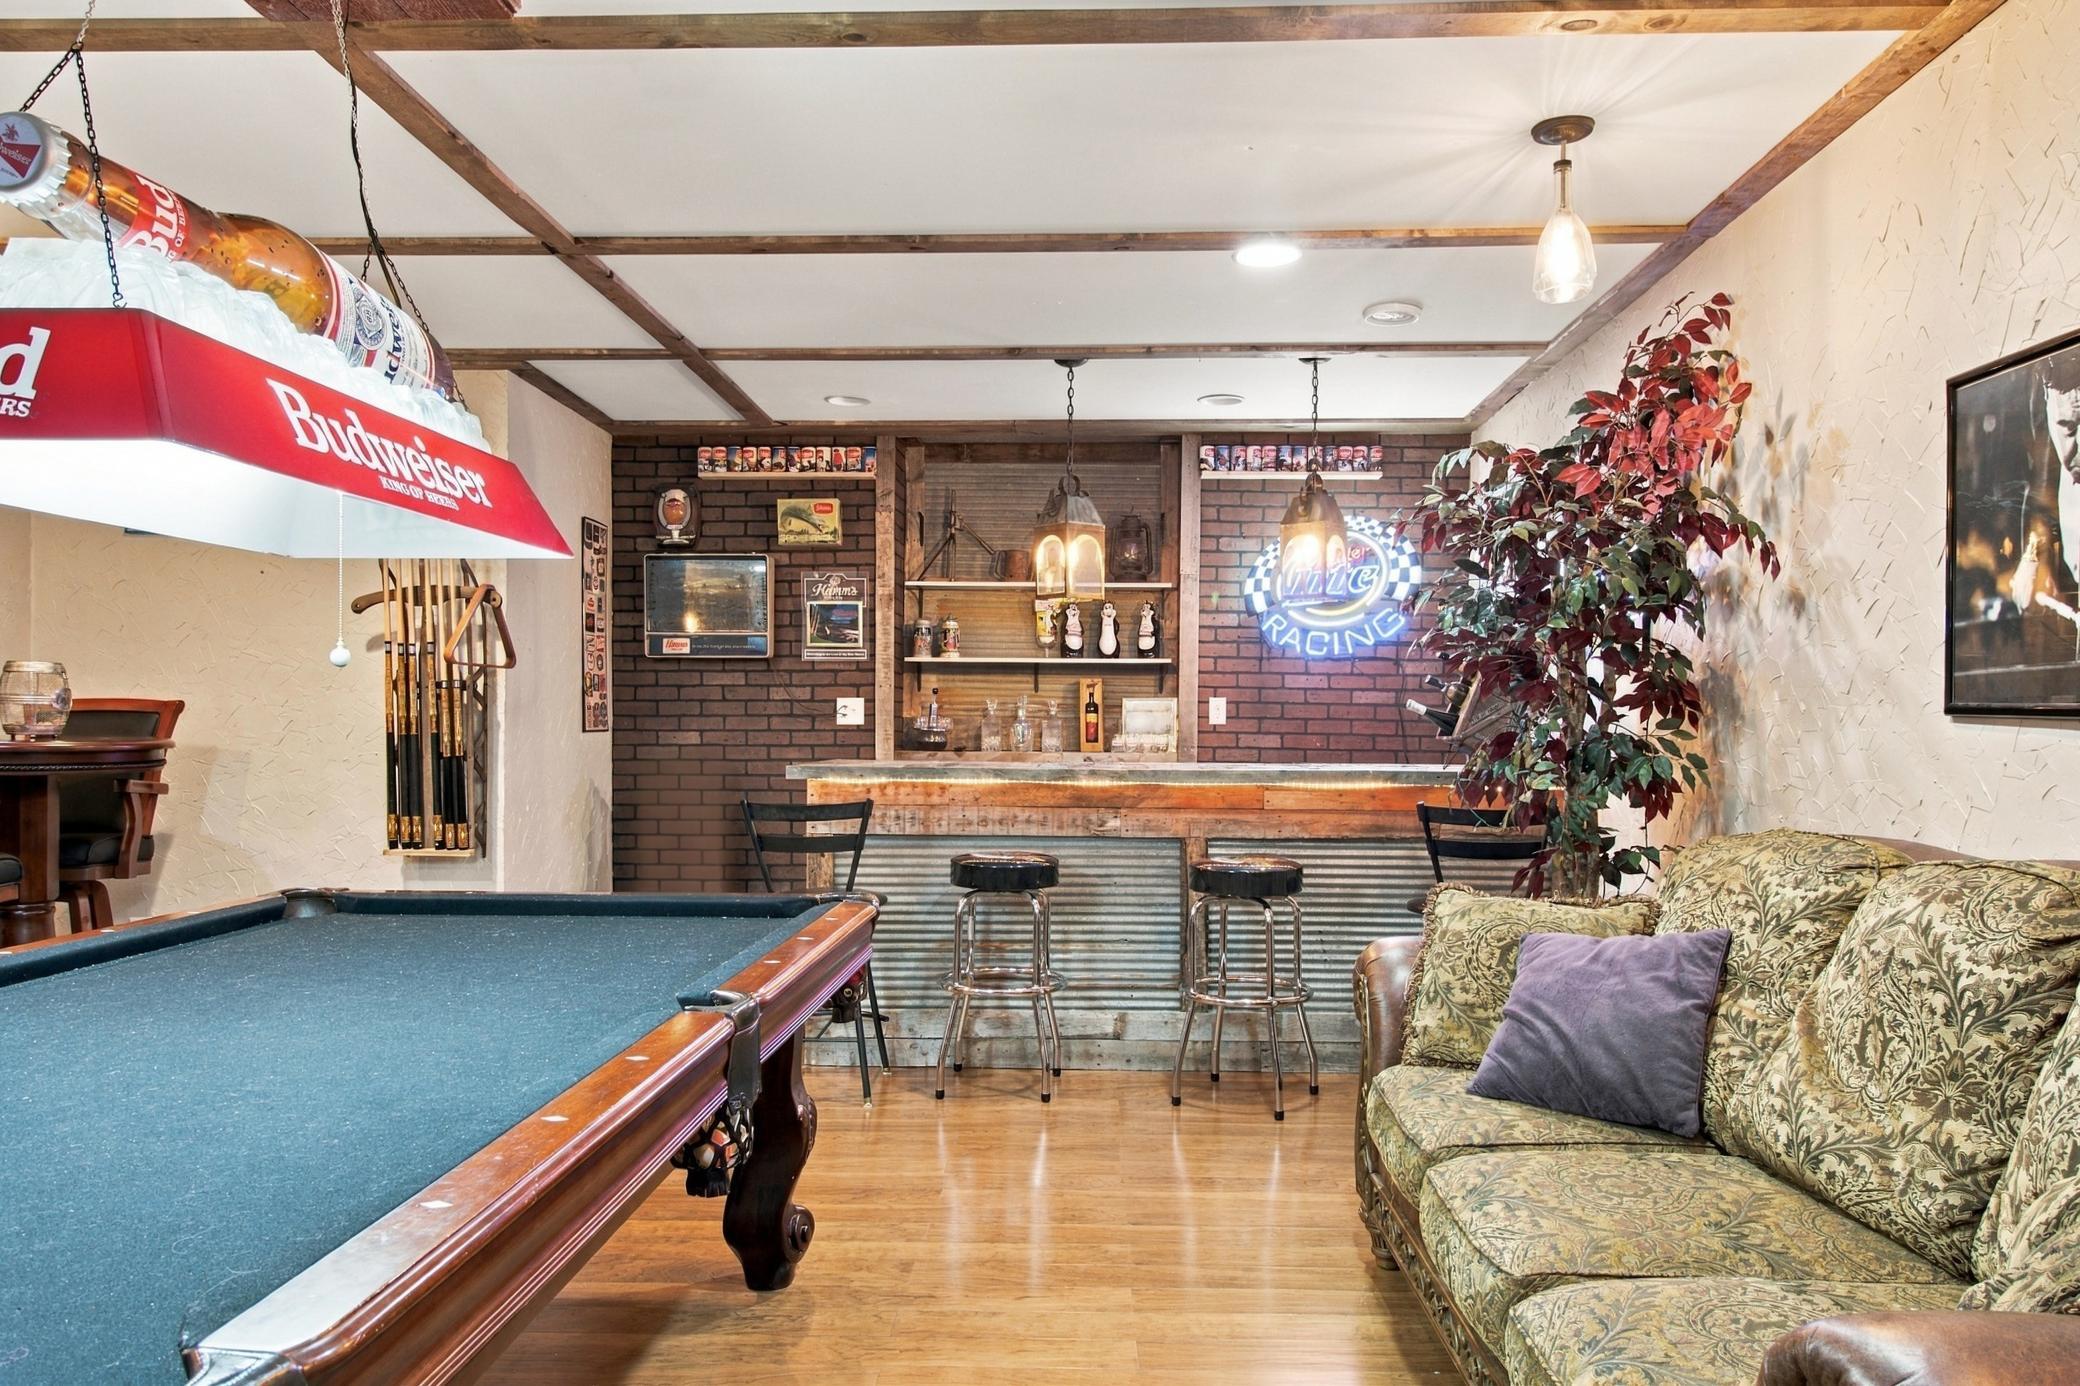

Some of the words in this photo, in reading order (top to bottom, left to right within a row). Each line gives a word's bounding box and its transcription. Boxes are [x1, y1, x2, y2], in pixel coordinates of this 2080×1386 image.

[265, 377, 493, 508] Budweiser
[379, 475, 410, 496] KING
[408, 484, 424, 500] OF
[1262, 607, 1405, 655] RACING
